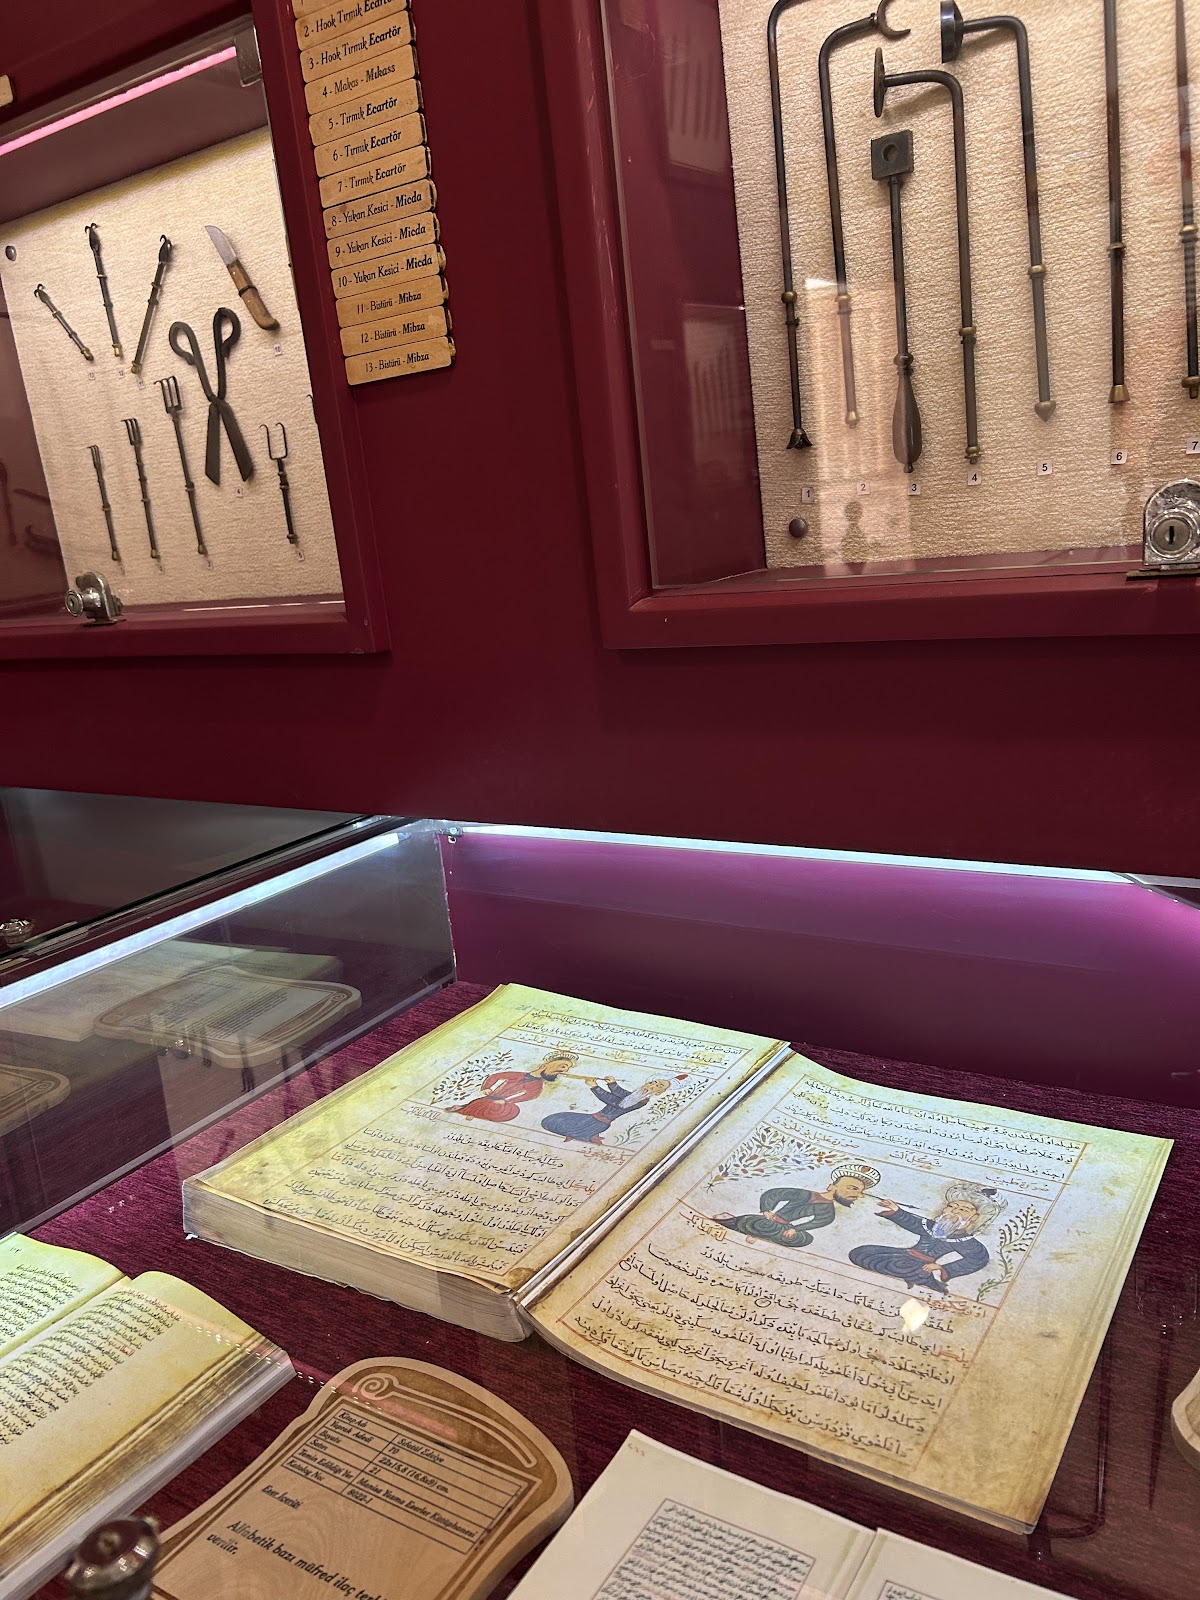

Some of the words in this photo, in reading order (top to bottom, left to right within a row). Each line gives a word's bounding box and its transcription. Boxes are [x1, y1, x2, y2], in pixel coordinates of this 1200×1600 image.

[304, 25, 309, 37] 2
[316, 14, 337, 32] Hook
[309, 57, 314, 70] 3
[321, 47, 342, 65] Hook
[369, 25, 401, 46] Ecartör
[322, 86, 328, 97] 4
[334, 78, 359, 94] Makas
[329, 117, 333, 130] 5
[366, 97, 397, 116] Ecartör
[333, 150, 338, 161] 6
[370, 130, 401, 149] Ecartör
[338, 181, 342, 192] 7
[375, 163, 406, 180] Ecartör
[332, 215, 337, 227] 8
[367, 200, 389, 217] Kesici
[395, 191, 422, 208] Micda
[335, 246, 340, 257] 9
[371, 232, 392, 248] Kesici
[399, 223, 426, 240] Micda
[377, 263, 400, 278] Kesici
[406, 254, 433, 270] Micda
[357, 304, 364, 314] 11
[399, 292, 422, 304] Mibza
[361, 333, 369, 344] 12
[403, 322, 425, 334] Mibza
[365, 362, 373, 372] 13
[407, 352, 429, 364] Mibza
[1116, 452, 1122, 461] 6
[1192, 441, 1198, 451] 7
[971, 473, 977, 483] 4
[1042, 463, 1048, 472] 5
[911, 483, 917, 492] 3
[369, 1467, 381, 1475] 21
[207, 1533, 238, 1555] verilir.
[226, 1521, 276, 1551] Alfabetik
[273, 1544, 295, 1562] bazı
[334, 1576, 356, 1596] ilaç
